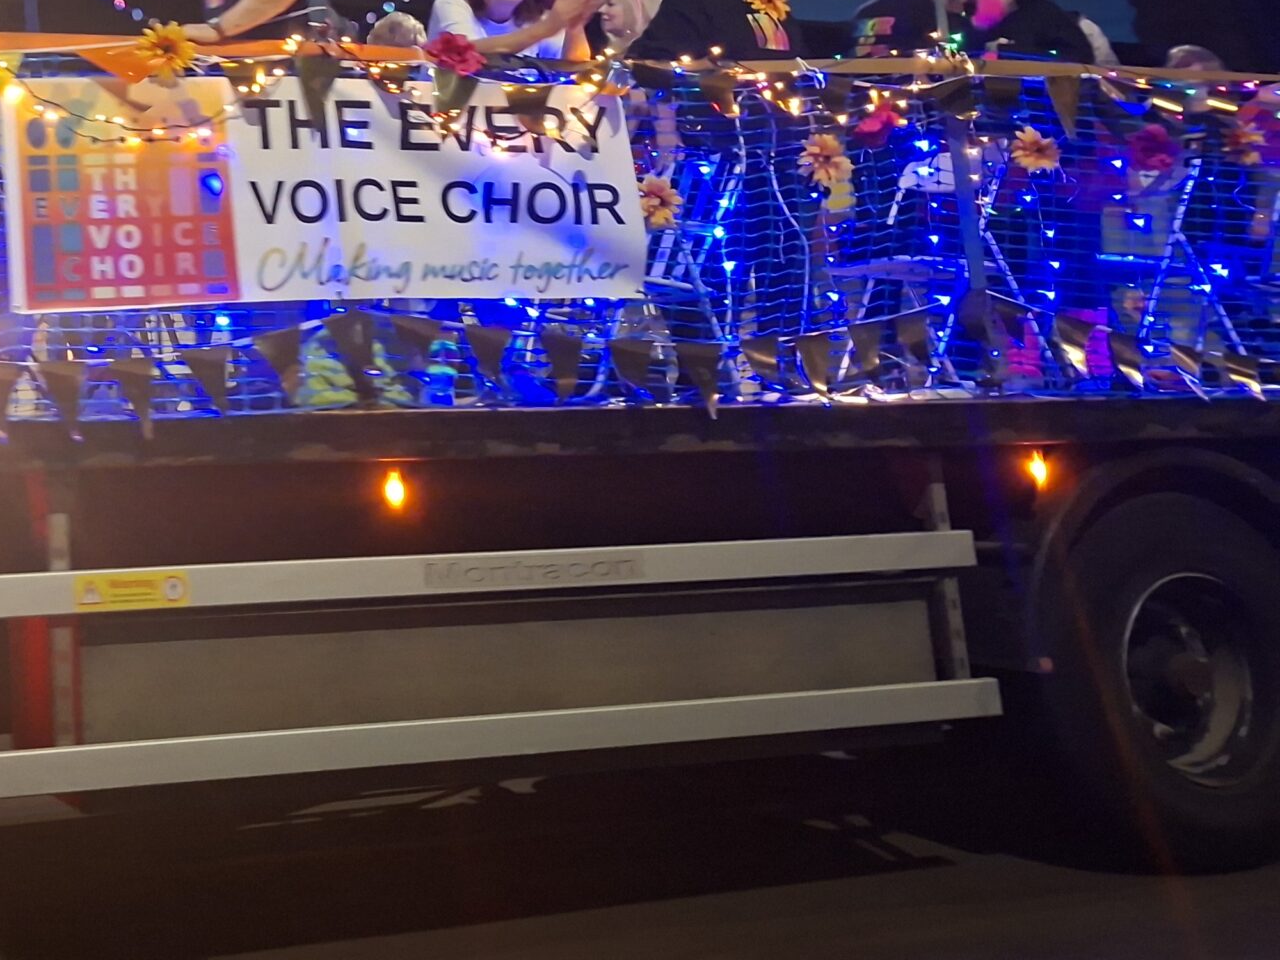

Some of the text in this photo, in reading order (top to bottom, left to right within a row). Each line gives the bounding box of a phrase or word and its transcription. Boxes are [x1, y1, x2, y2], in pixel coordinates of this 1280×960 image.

[245, 100, 607, 153] THE EVERY
[85, 166, 166, 192] TH
[250, 178, 626, 225] VOICE CHOIR
[88, 222, 220, 249] VOICE
[62, 252, 198, 281] CHOIR
[256, 238, 631, 295] Making music together
